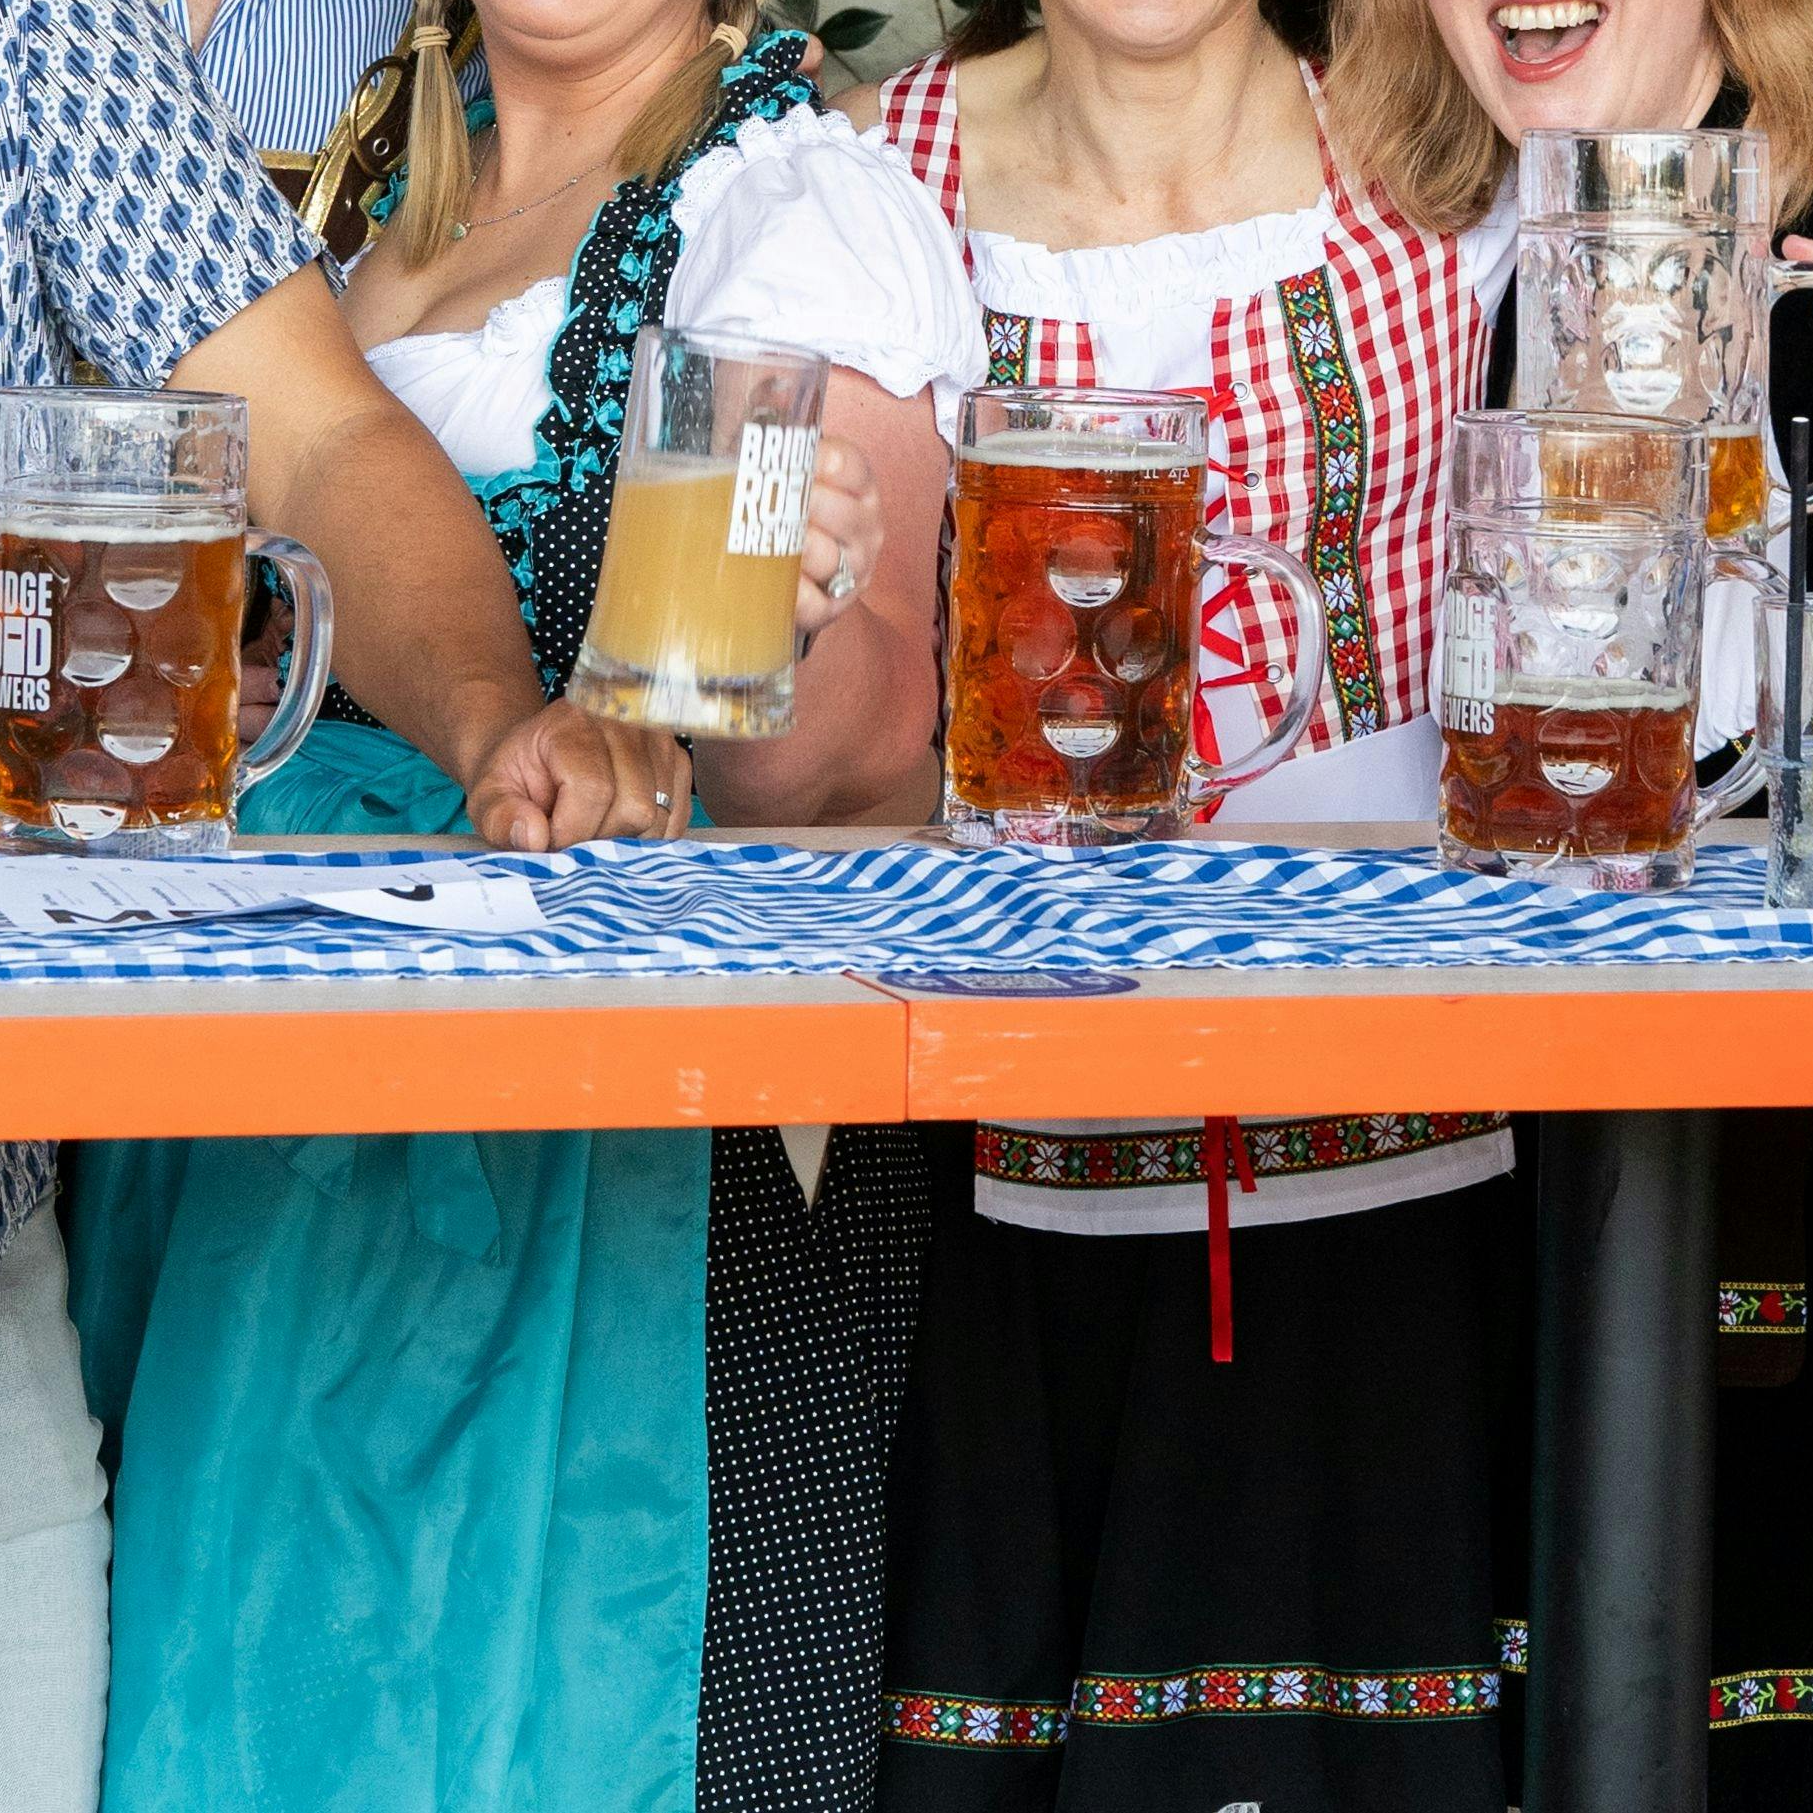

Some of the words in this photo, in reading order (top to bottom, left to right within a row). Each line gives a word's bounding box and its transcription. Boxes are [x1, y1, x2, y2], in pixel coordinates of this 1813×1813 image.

[1444, 587, 1497, 639] IDGE
[1443, 634, 1496, 700] OAD
[1442, 695, 1495, 736] EWERS
